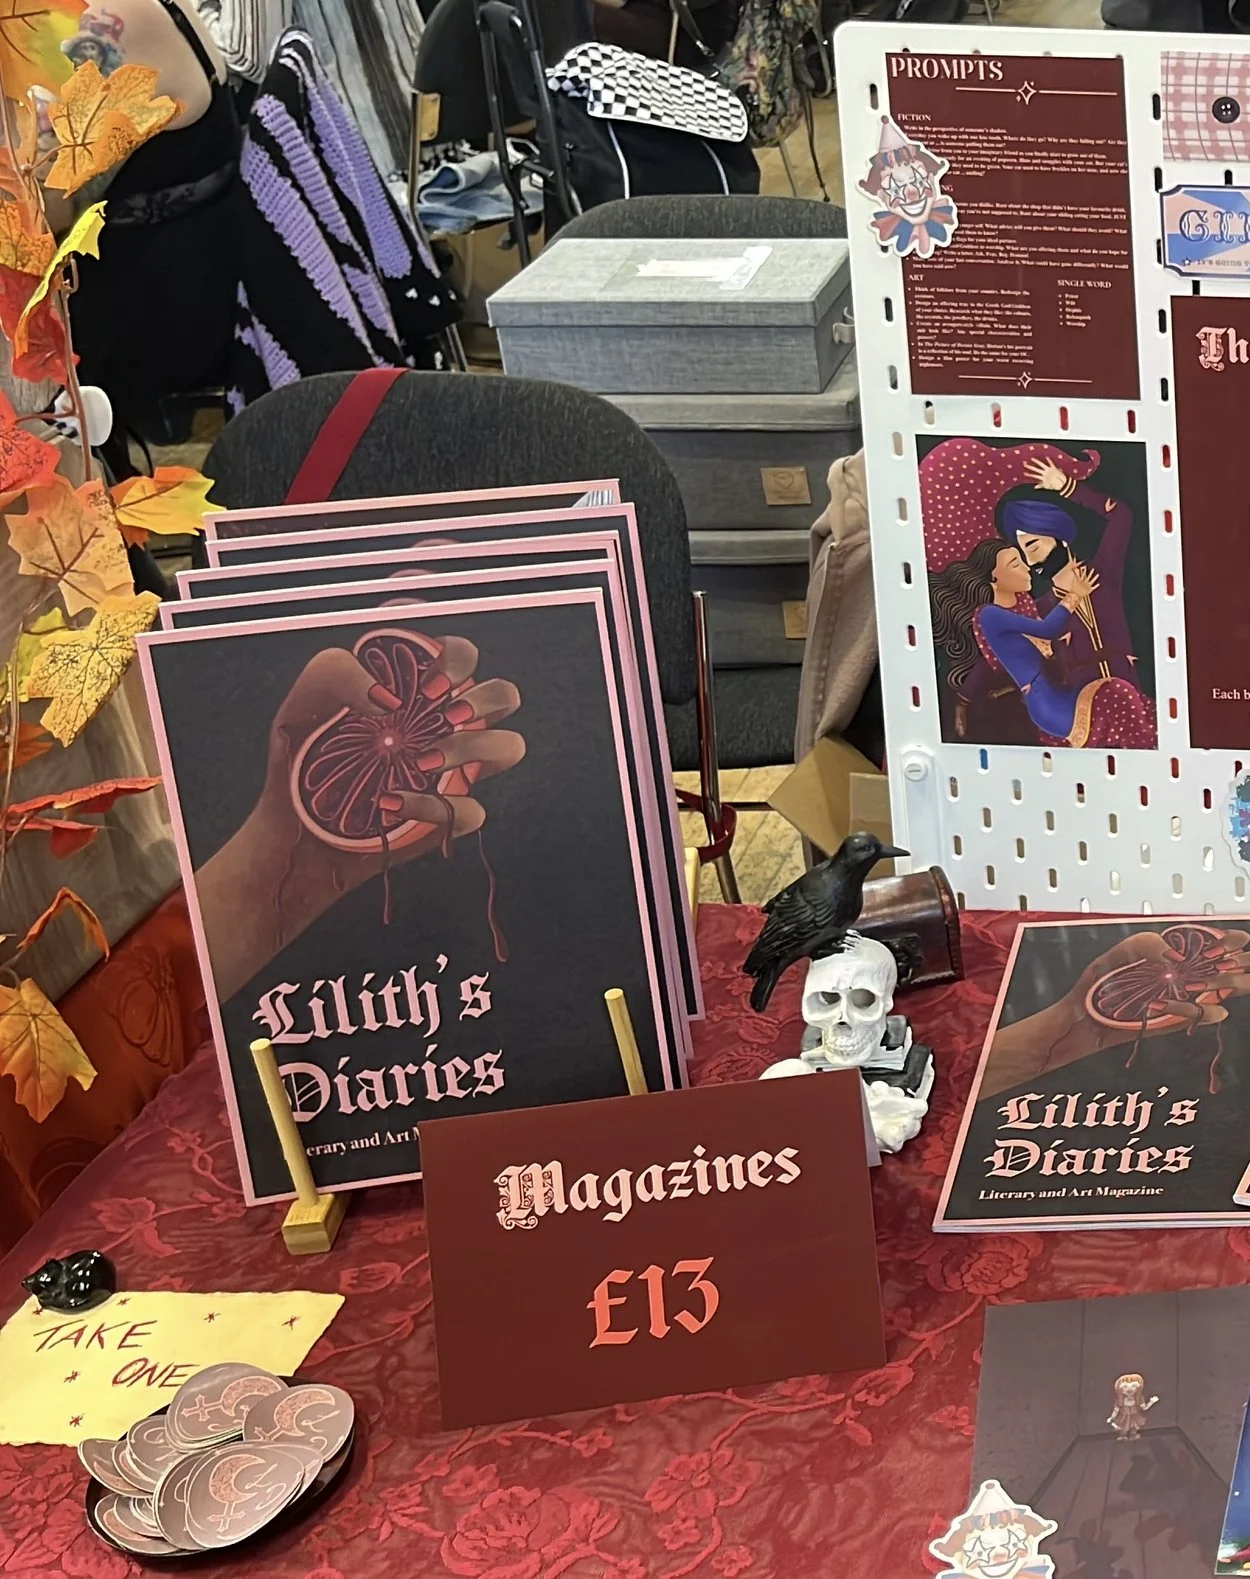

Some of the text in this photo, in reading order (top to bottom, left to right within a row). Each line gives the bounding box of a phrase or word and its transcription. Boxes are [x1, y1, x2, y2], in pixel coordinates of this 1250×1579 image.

[891, 57, 1003, 81] PROMPTS
[897, 113, 931, 121] FICTION
[1086, 281, 1112, 289] WORD
[1212, 688, 1241, 700] Each
[252, 953, 492, 1045] Lilith's
[279, 1044, 506, 1123] Diaries
[997, 1086, 1200, 1135] Lilith's
[350, 1132, 380, 1150] and
[383, 1130, 409, 1146] Art
[983, 1137, 1195, 1178] Diaries
[494, 1144, 802, 1230] Magazines
[978, 1185, 1164, 1201] Literary and Art Magazine
[586, 1256, 721, 1349] £13
[33, 1319, 157, 1352] TAKE
[111, 1357, 201, 1389] ONE
